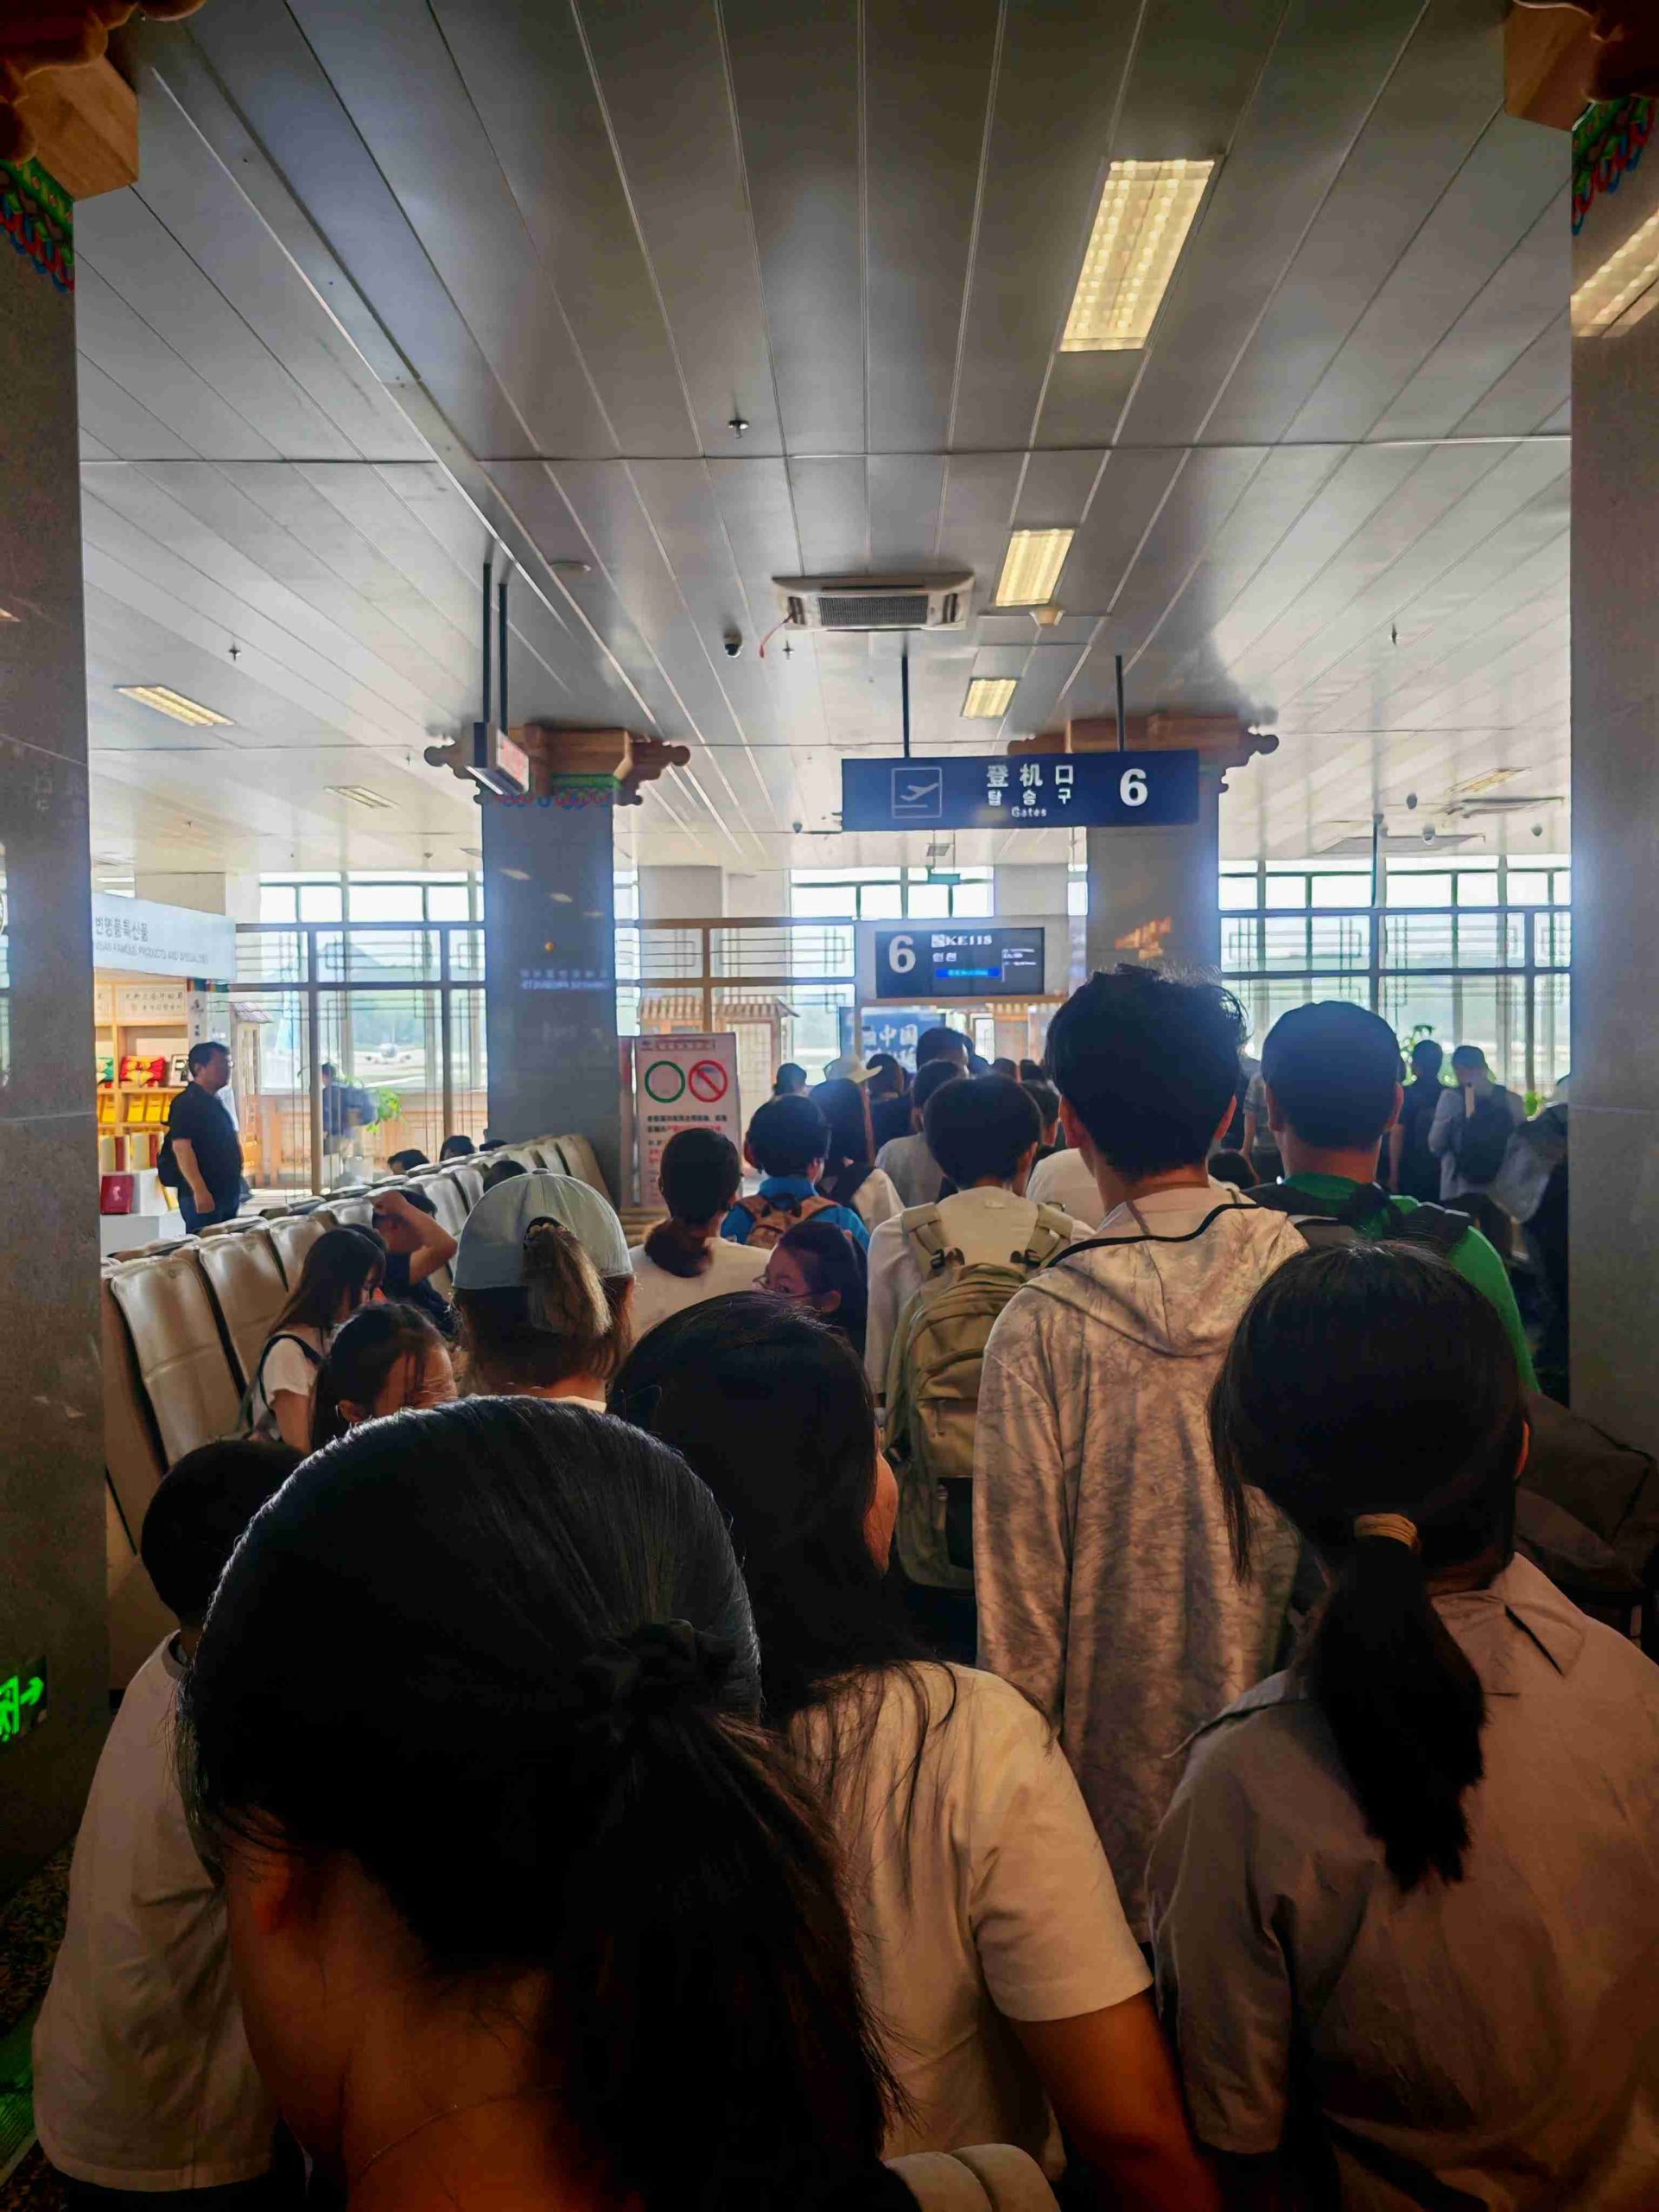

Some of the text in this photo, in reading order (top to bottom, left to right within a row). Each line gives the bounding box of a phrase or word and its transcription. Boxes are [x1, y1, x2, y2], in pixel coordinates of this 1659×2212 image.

[986, 763, 1074, 788] 登机口
[1119, 767, 1148, 807] 6
[1011, 805, 1047, 818] Gates
[888, 934, 917, 974] 6
